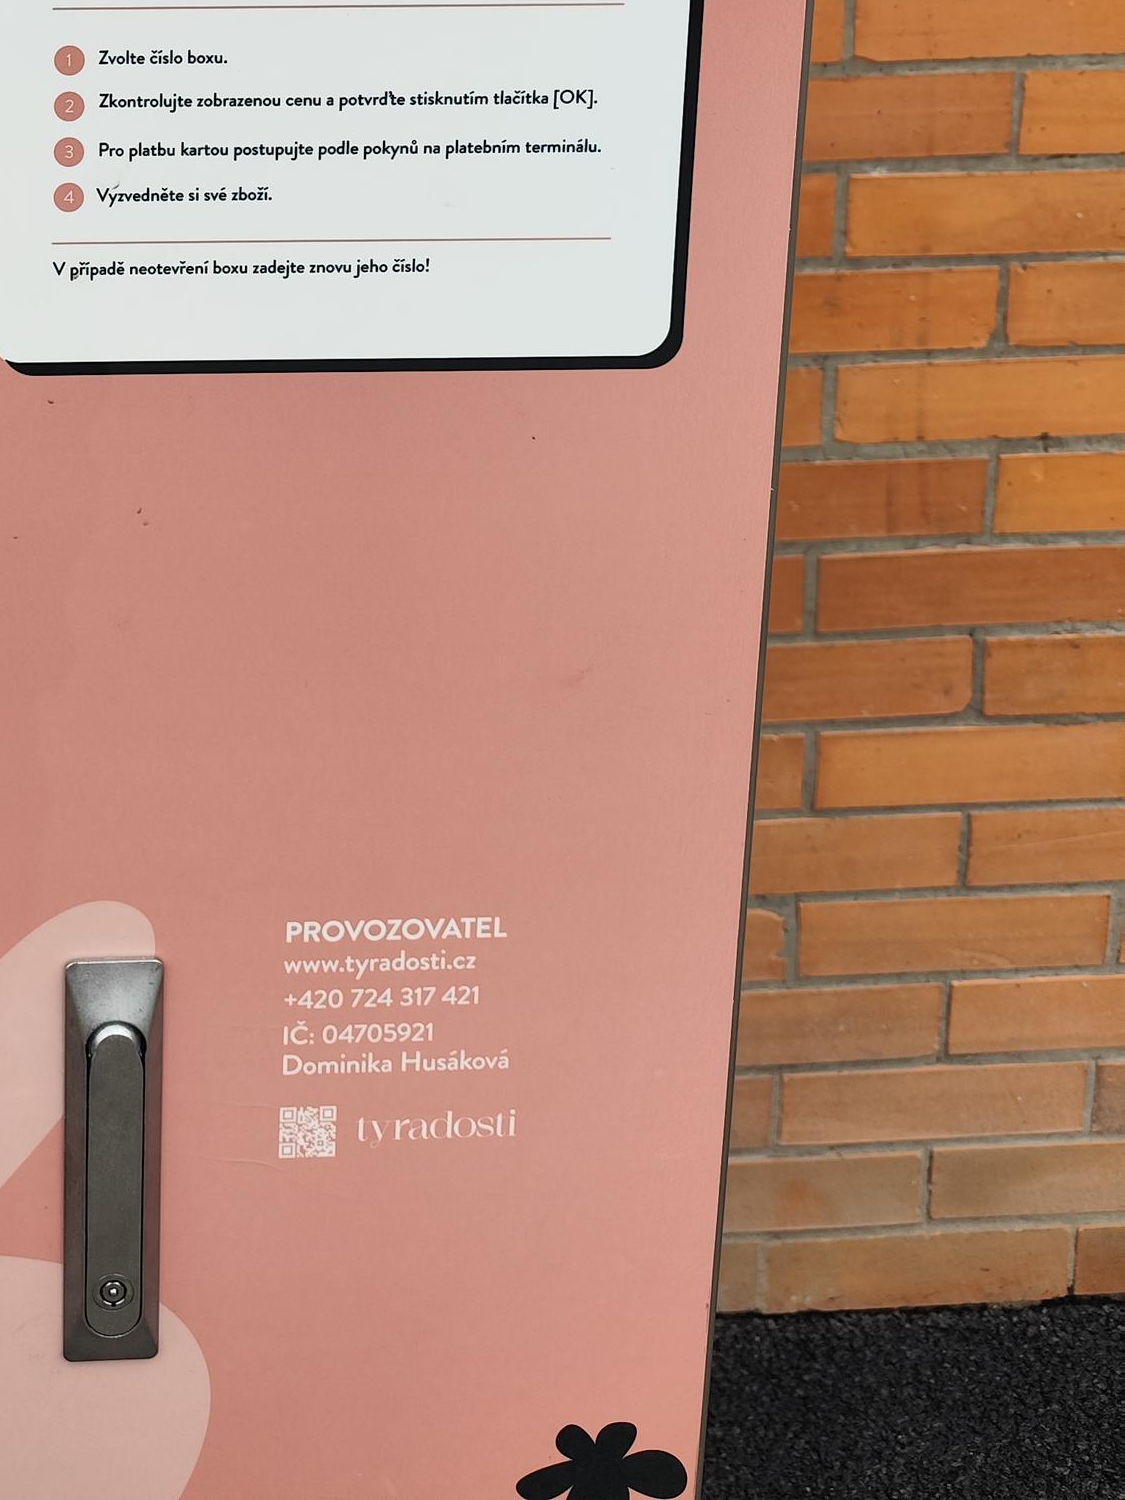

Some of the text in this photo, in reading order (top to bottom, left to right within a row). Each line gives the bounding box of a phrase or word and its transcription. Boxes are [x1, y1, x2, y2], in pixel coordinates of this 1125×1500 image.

[98, 50, 146, 65] Zvolte
[149, 49, 183, 65] číslo
[187, 49, 228, 64] boxu.
[64, 89, 598, 114] 2 Zkontrolujte zobrazenou cenu a potvrďte stisknutím tlačítka [OK].
[64, 138, 602, 161] 3 Pro platbu kartou postupujte podle pokynů na platebním terminálu.
[63, 190, 75, 205] 4
[188, 188, 200, 202] si
[204, 187, 227, 201] své
[231, 186, 273, 202] zboží.
[53, 257, 430, 281] V případě neotevření boxu zadejte znovu jeho číslo!
[286, 917, 508, 943] PROVOZOVATEL
[284, 949, 477, 980] www.tyradosti.cz
[284, 986, 480, 1009] +420 724 317 421
[283, 1020, 434, 1045] IČ: 04705921
[282, 1048, 510, 1076] Dominika Husáková
[356, 1109, 517, 1148] tyradosti
